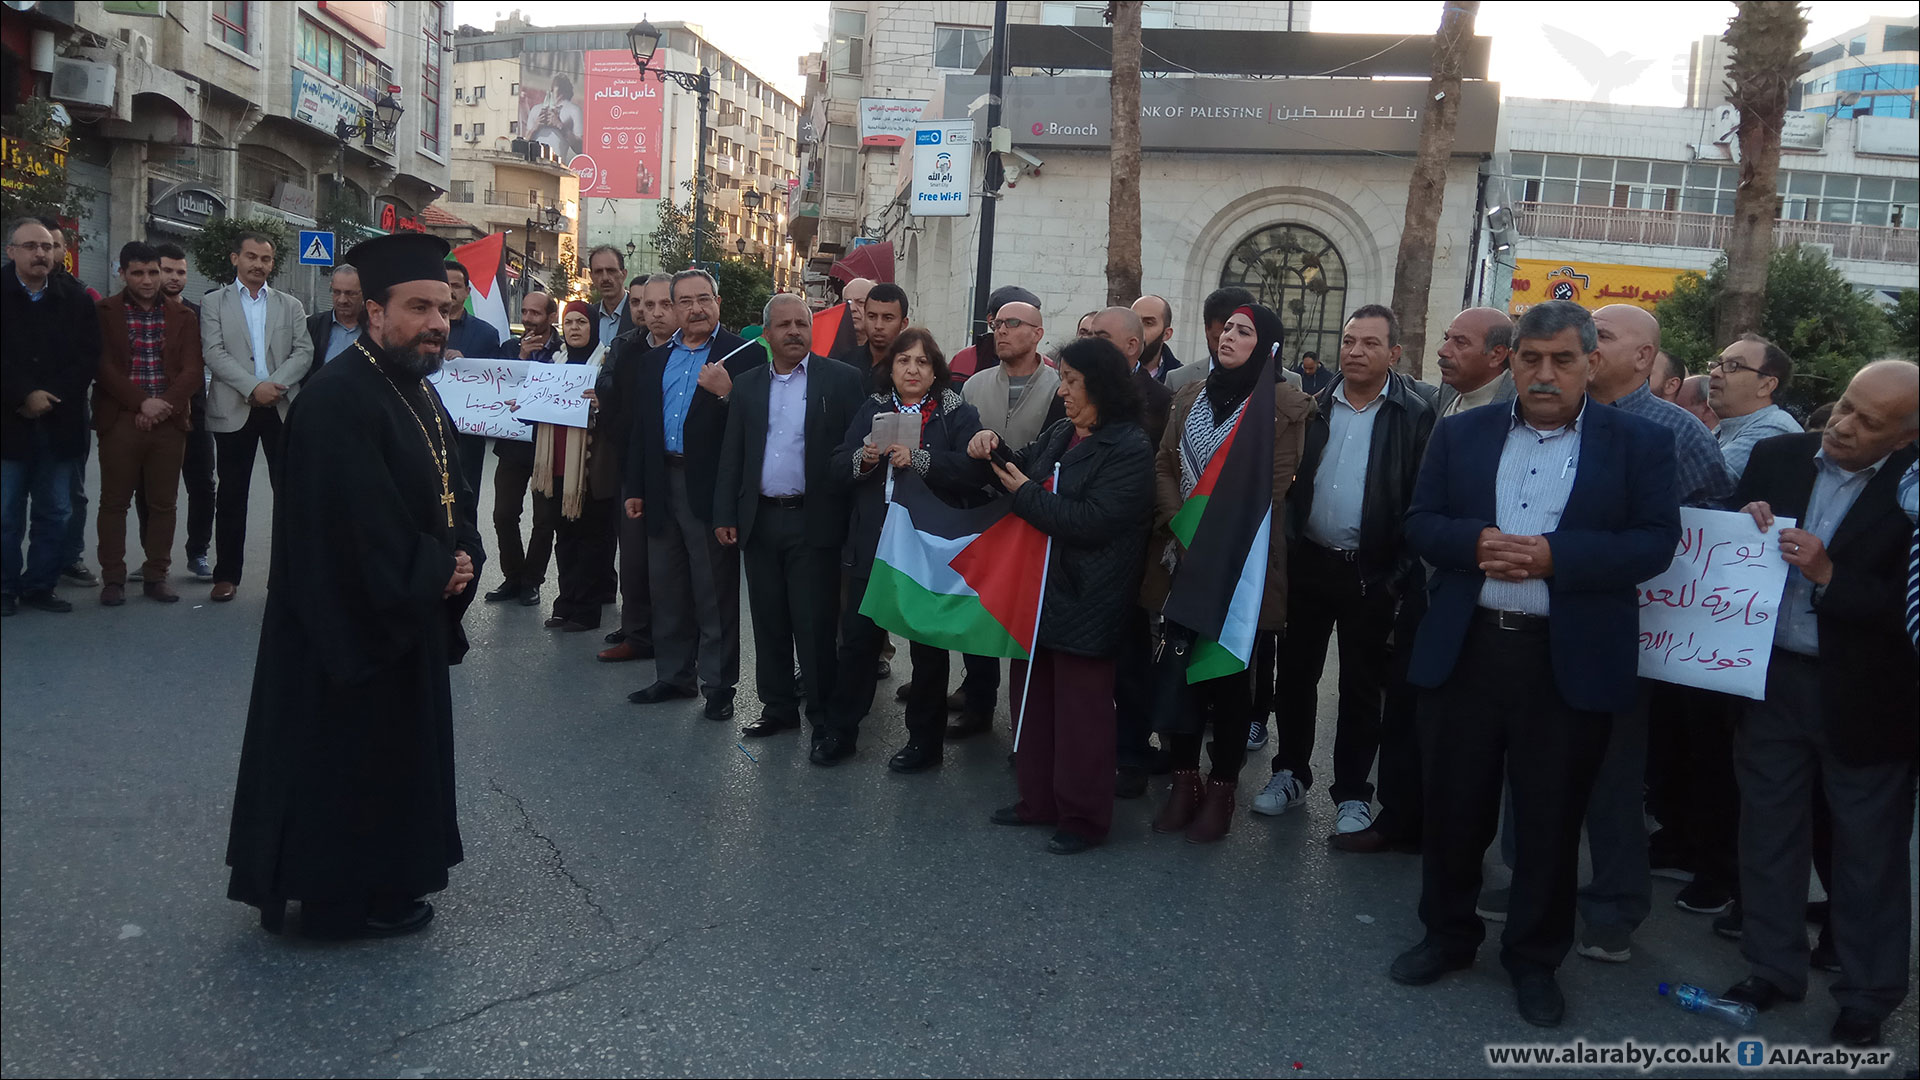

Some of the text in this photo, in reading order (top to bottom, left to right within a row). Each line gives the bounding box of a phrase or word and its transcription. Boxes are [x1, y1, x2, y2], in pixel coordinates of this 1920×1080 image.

[594, 84, 656, 101] كأس العالم
[1139, 106, 1263, 119] NK OF PALESTINE
[1277, 100, 1418, 123] بنك فلسطين
[1031, 121, 1098, 136] e-Branch
[928, 171, 952, 183] رام الله
[178, 192, 214, 217] فلسطين
[919, 192, 962, 201] Free Wi-Fi
[1674, 527, 1768, 581] يوم الا
